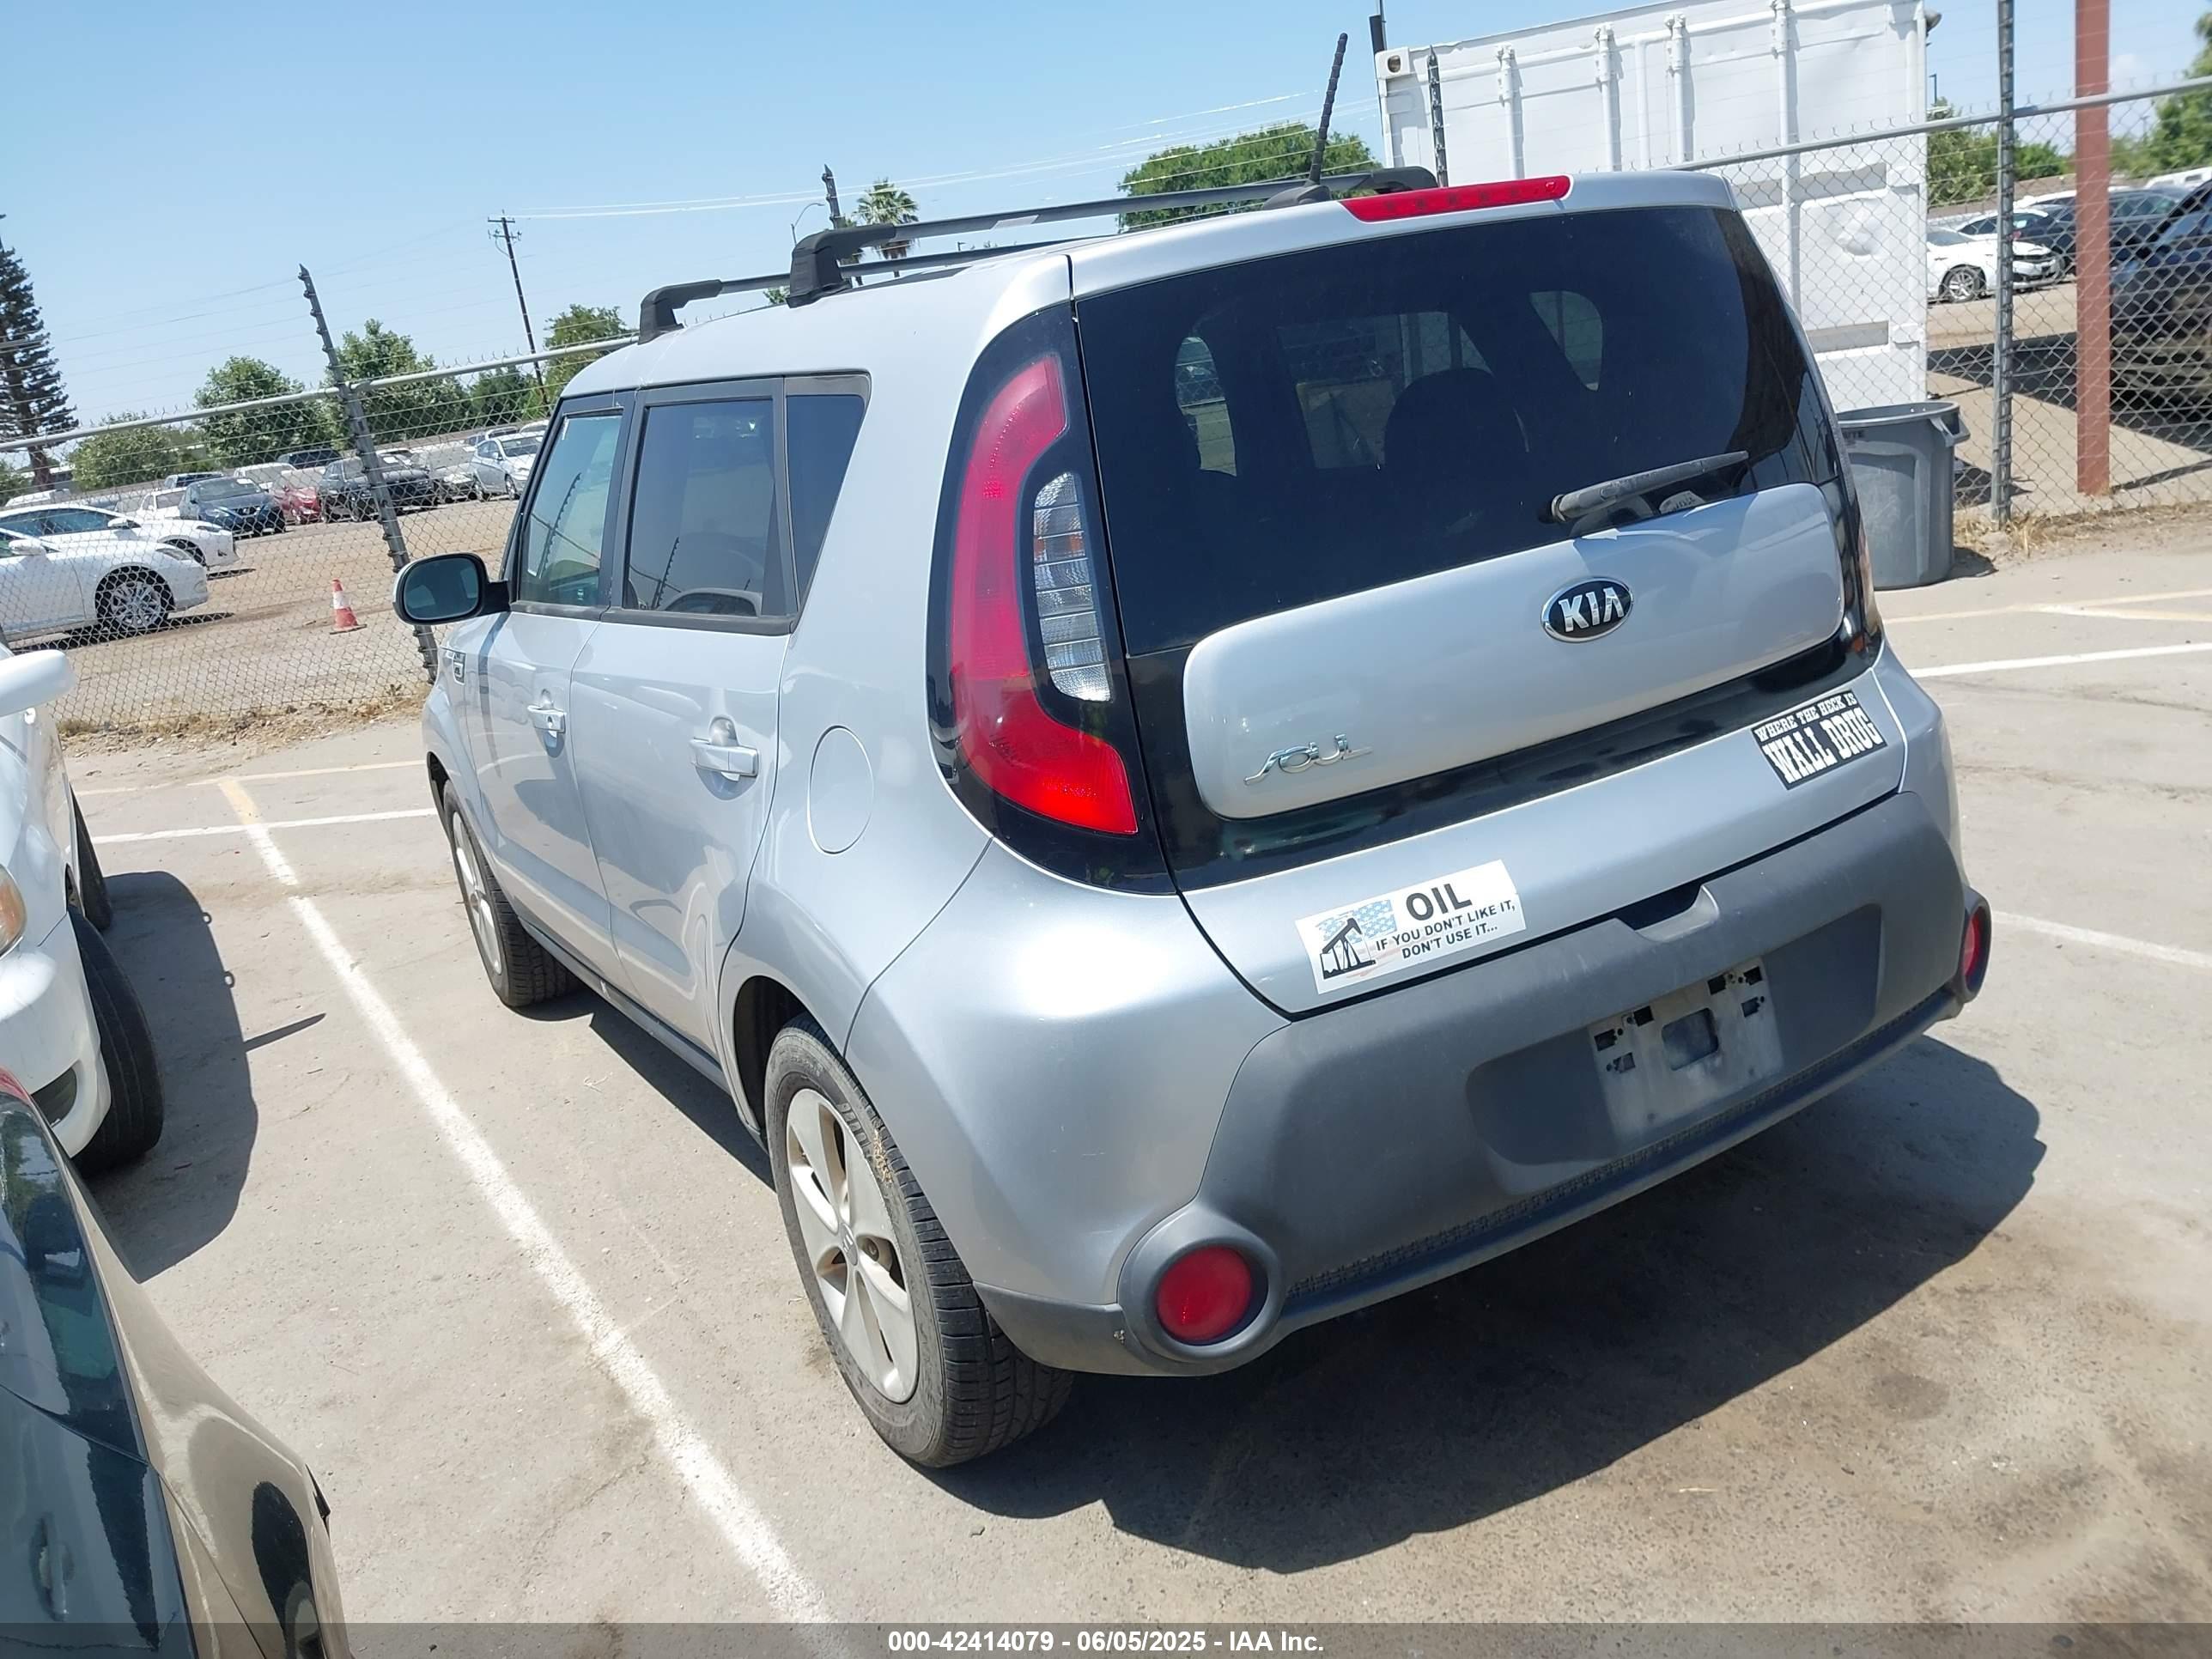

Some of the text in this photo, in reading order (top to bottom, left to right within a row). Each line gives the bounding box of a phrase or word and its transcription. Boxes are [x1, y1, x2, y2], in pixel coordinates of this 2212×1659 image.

[1558, 586, 1625, 633] KIA
[1753, 692, 1857, 742] WHERE THE HECK IS
[1761, 707, 1884, 784] WALL DRUG
[1376, 900, 1516, 951] IF YOU DON'T LIKE IT,
[1406, 883, 1473, 921] OIL
[1401, 921, 1498, 959] DON'T USE IT...
